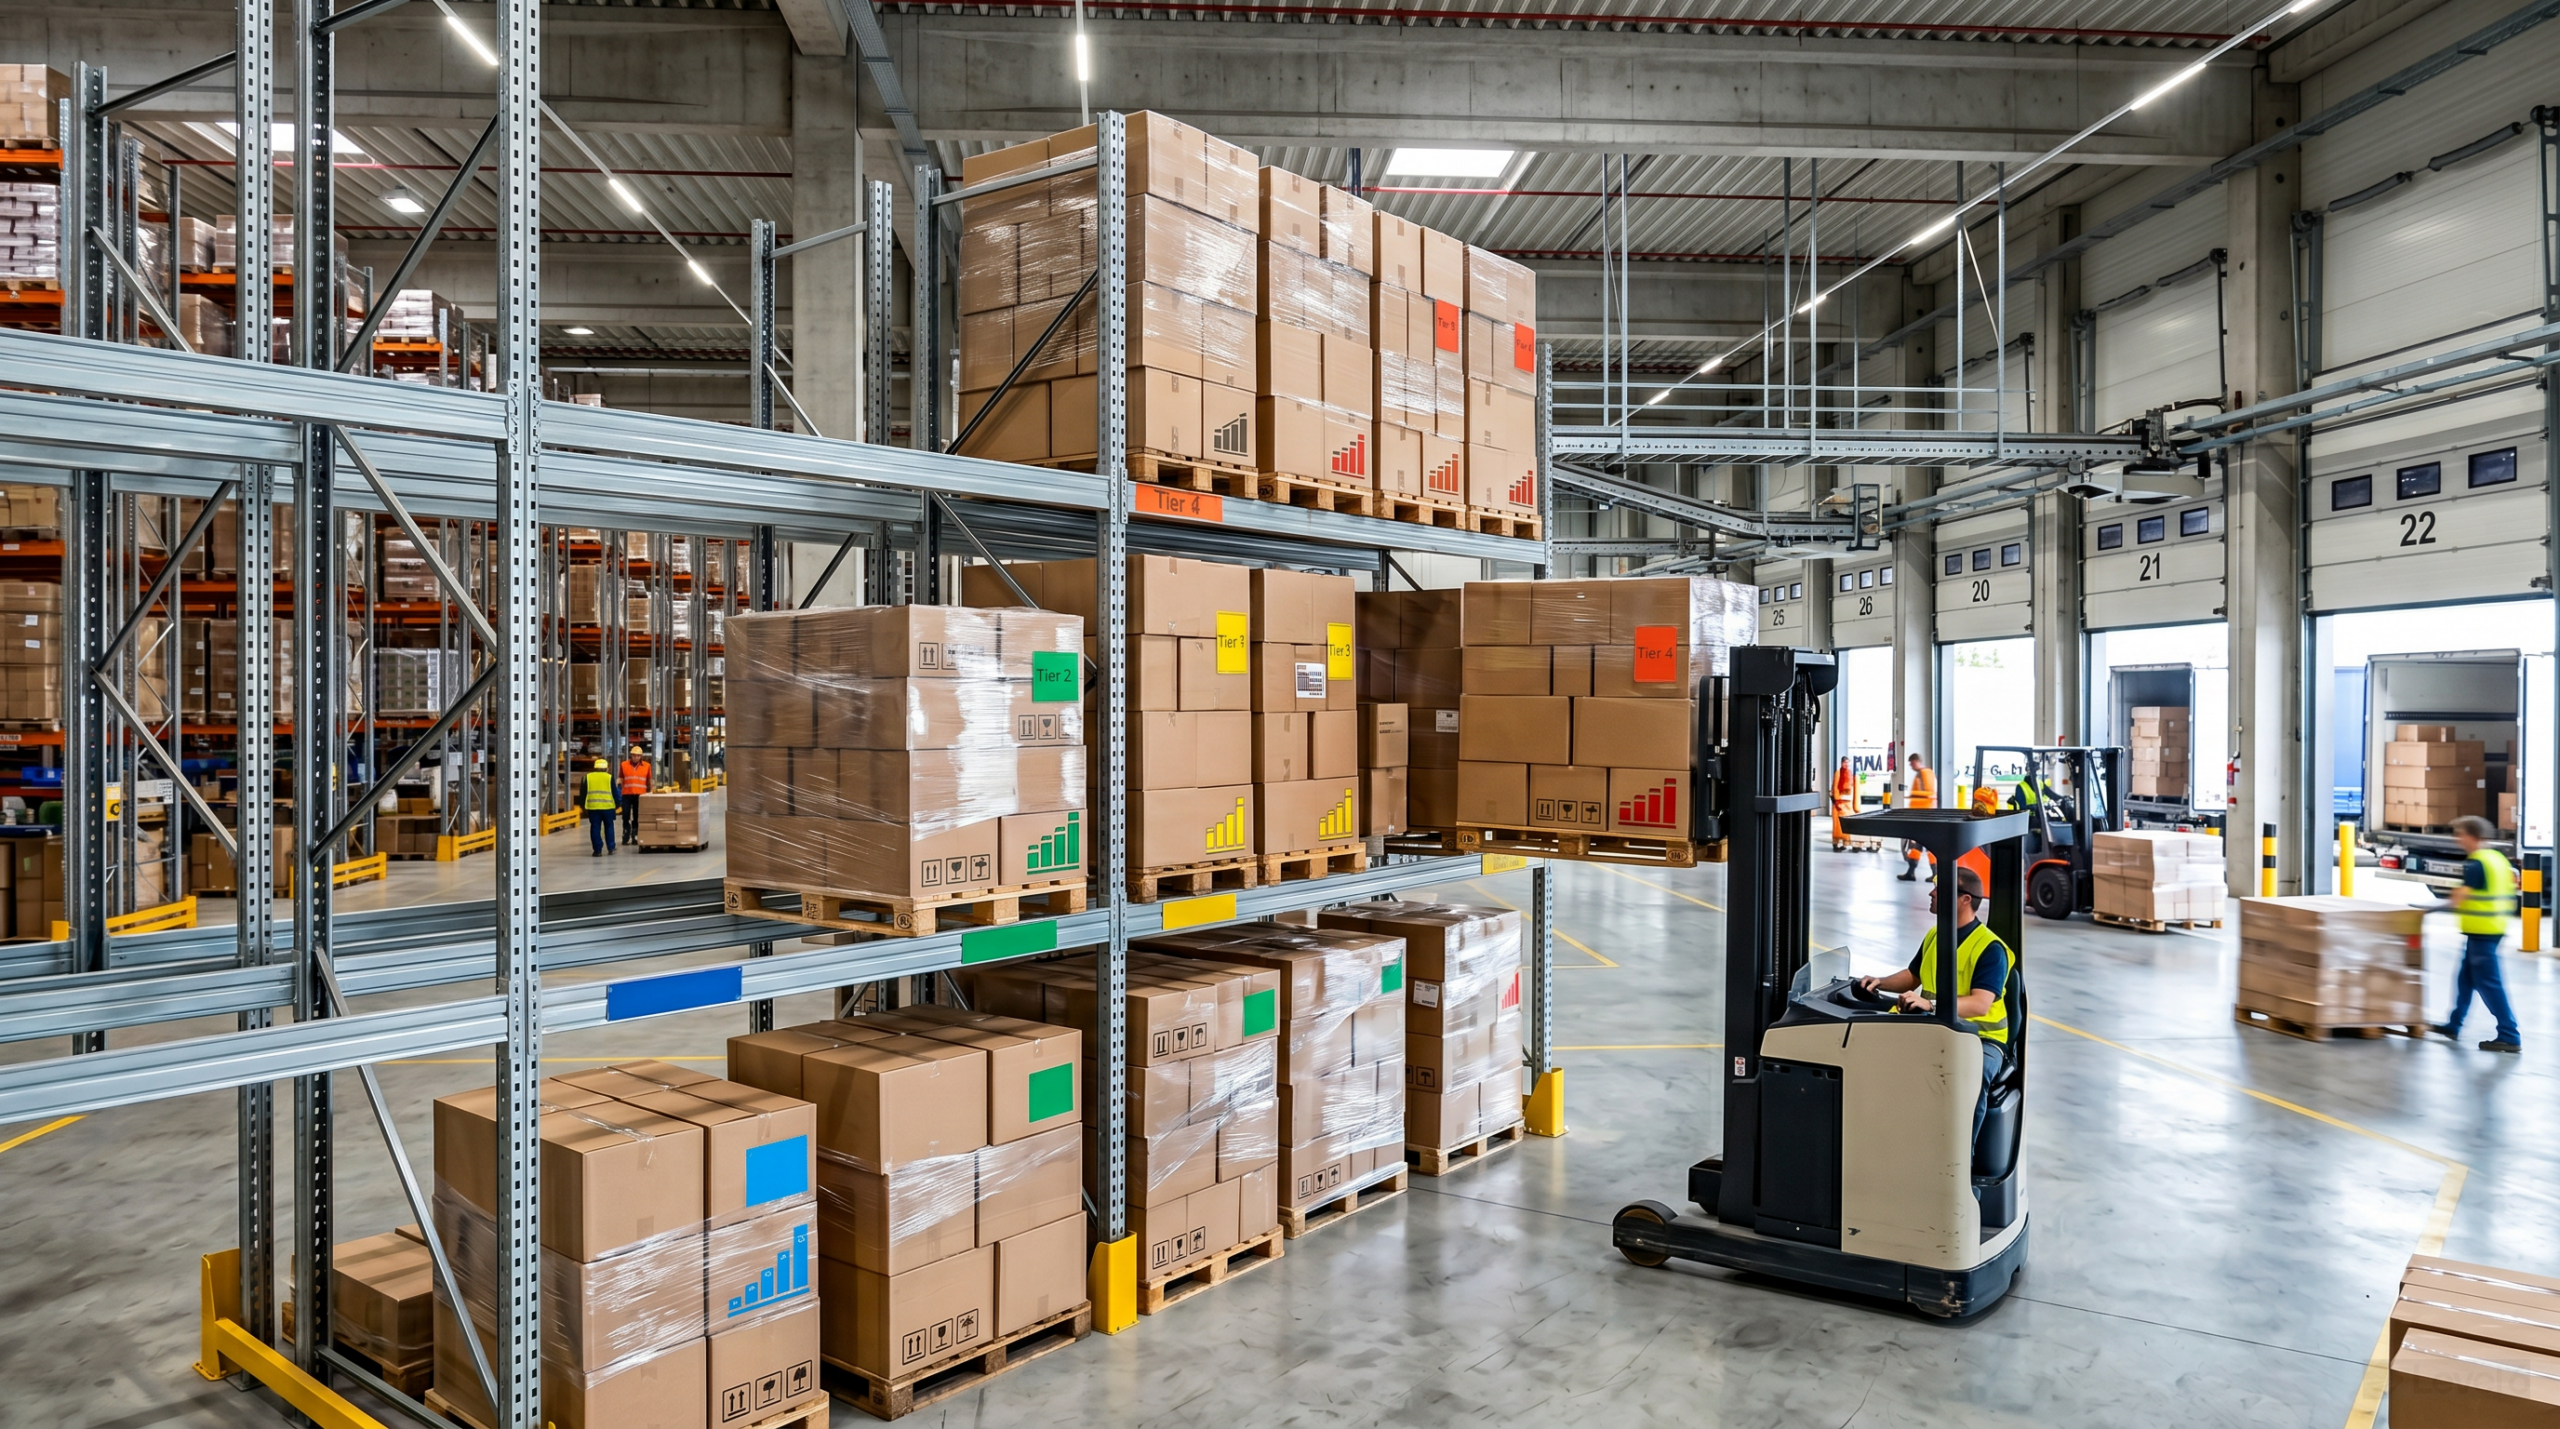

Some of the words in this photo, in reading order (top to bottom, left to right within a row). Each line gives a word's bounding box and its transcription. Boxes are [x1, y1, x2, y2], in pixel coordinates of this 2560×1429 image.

[1154, 488, 1185, 512] Tier
[2400, 511, 2436, 547] 22
[2140, 552, 2160, 581] 21
[1972, 579, 1990, 602] 20
[1859, 595, 1873, 616] 26
[1217, 634, 1238, 649] Tier
[1328, 644, 1344, 656] Tier
[1345, 643, 1351, 657] 3
[1637, 646, 1661, 659] Tier
[1664, 646, 1673, 659] 4
[1036, 668, 1061, 682] Tier
[1063, 668, 1072, 682] 2
